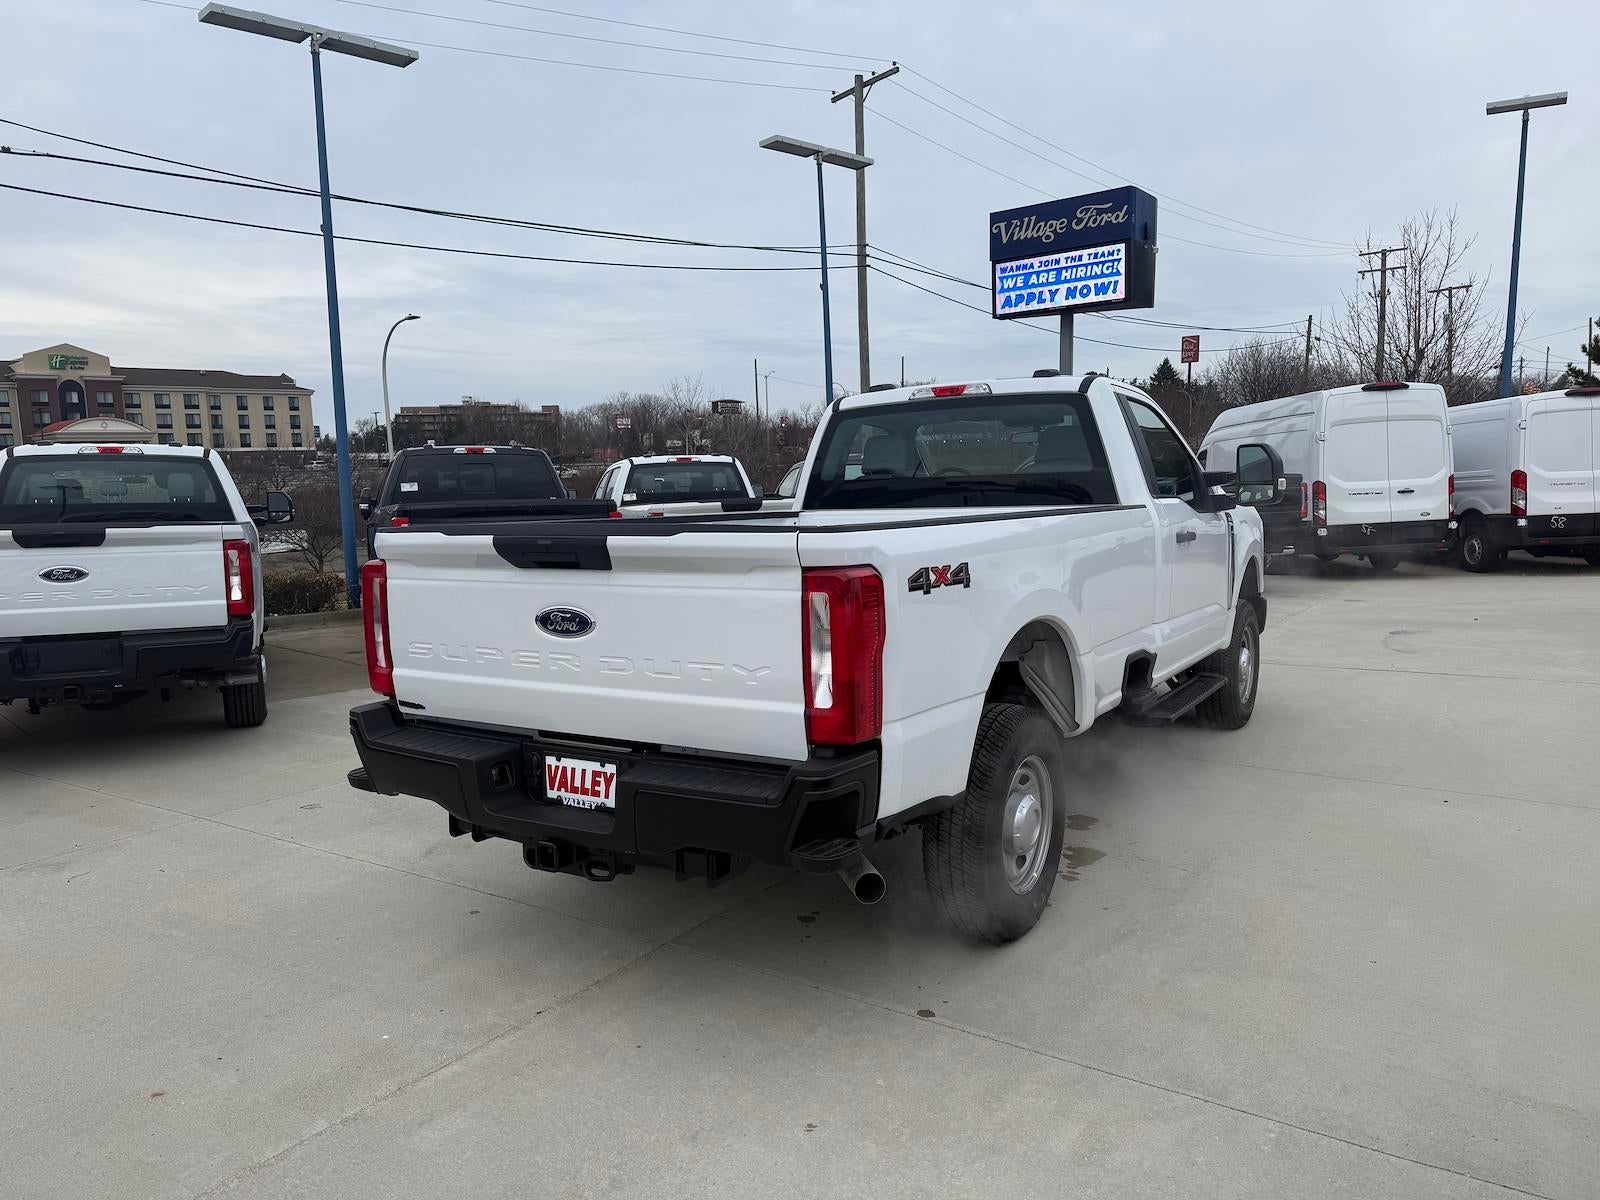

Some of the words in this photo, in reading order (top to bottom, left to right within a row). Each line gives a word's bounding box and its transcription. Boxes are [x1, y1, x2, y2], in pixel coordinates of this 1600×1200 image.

[991, 215, 1068, 244] Village
[1072, 202, 1129, 231] Ford
[1000, 262, 1035, 275] WANNA
[1038, 257, 1061, 269] JOIN
[1064, 254, 1084, 265] THE
[1087, 248, 1122, 260] TEAM?
[1002, 275, 1025, 289] WE
[1028, 270, 1057, 286] ARE
[1060, 260, 1119, 281] HIRING!
[1000, 288, 1060, 310] APPLY
[1064, 280, 1120, 301] NOW!
[1550, 515, 1567, 529] 58
[547, 611, 580, 632] Ford
[407, 640, 582, 672] SUPER
[599, 655, 771, 685] DUTY
[547, 763, 616, 800] VALLEY
[562, 797, 598, 810] VALLEY
